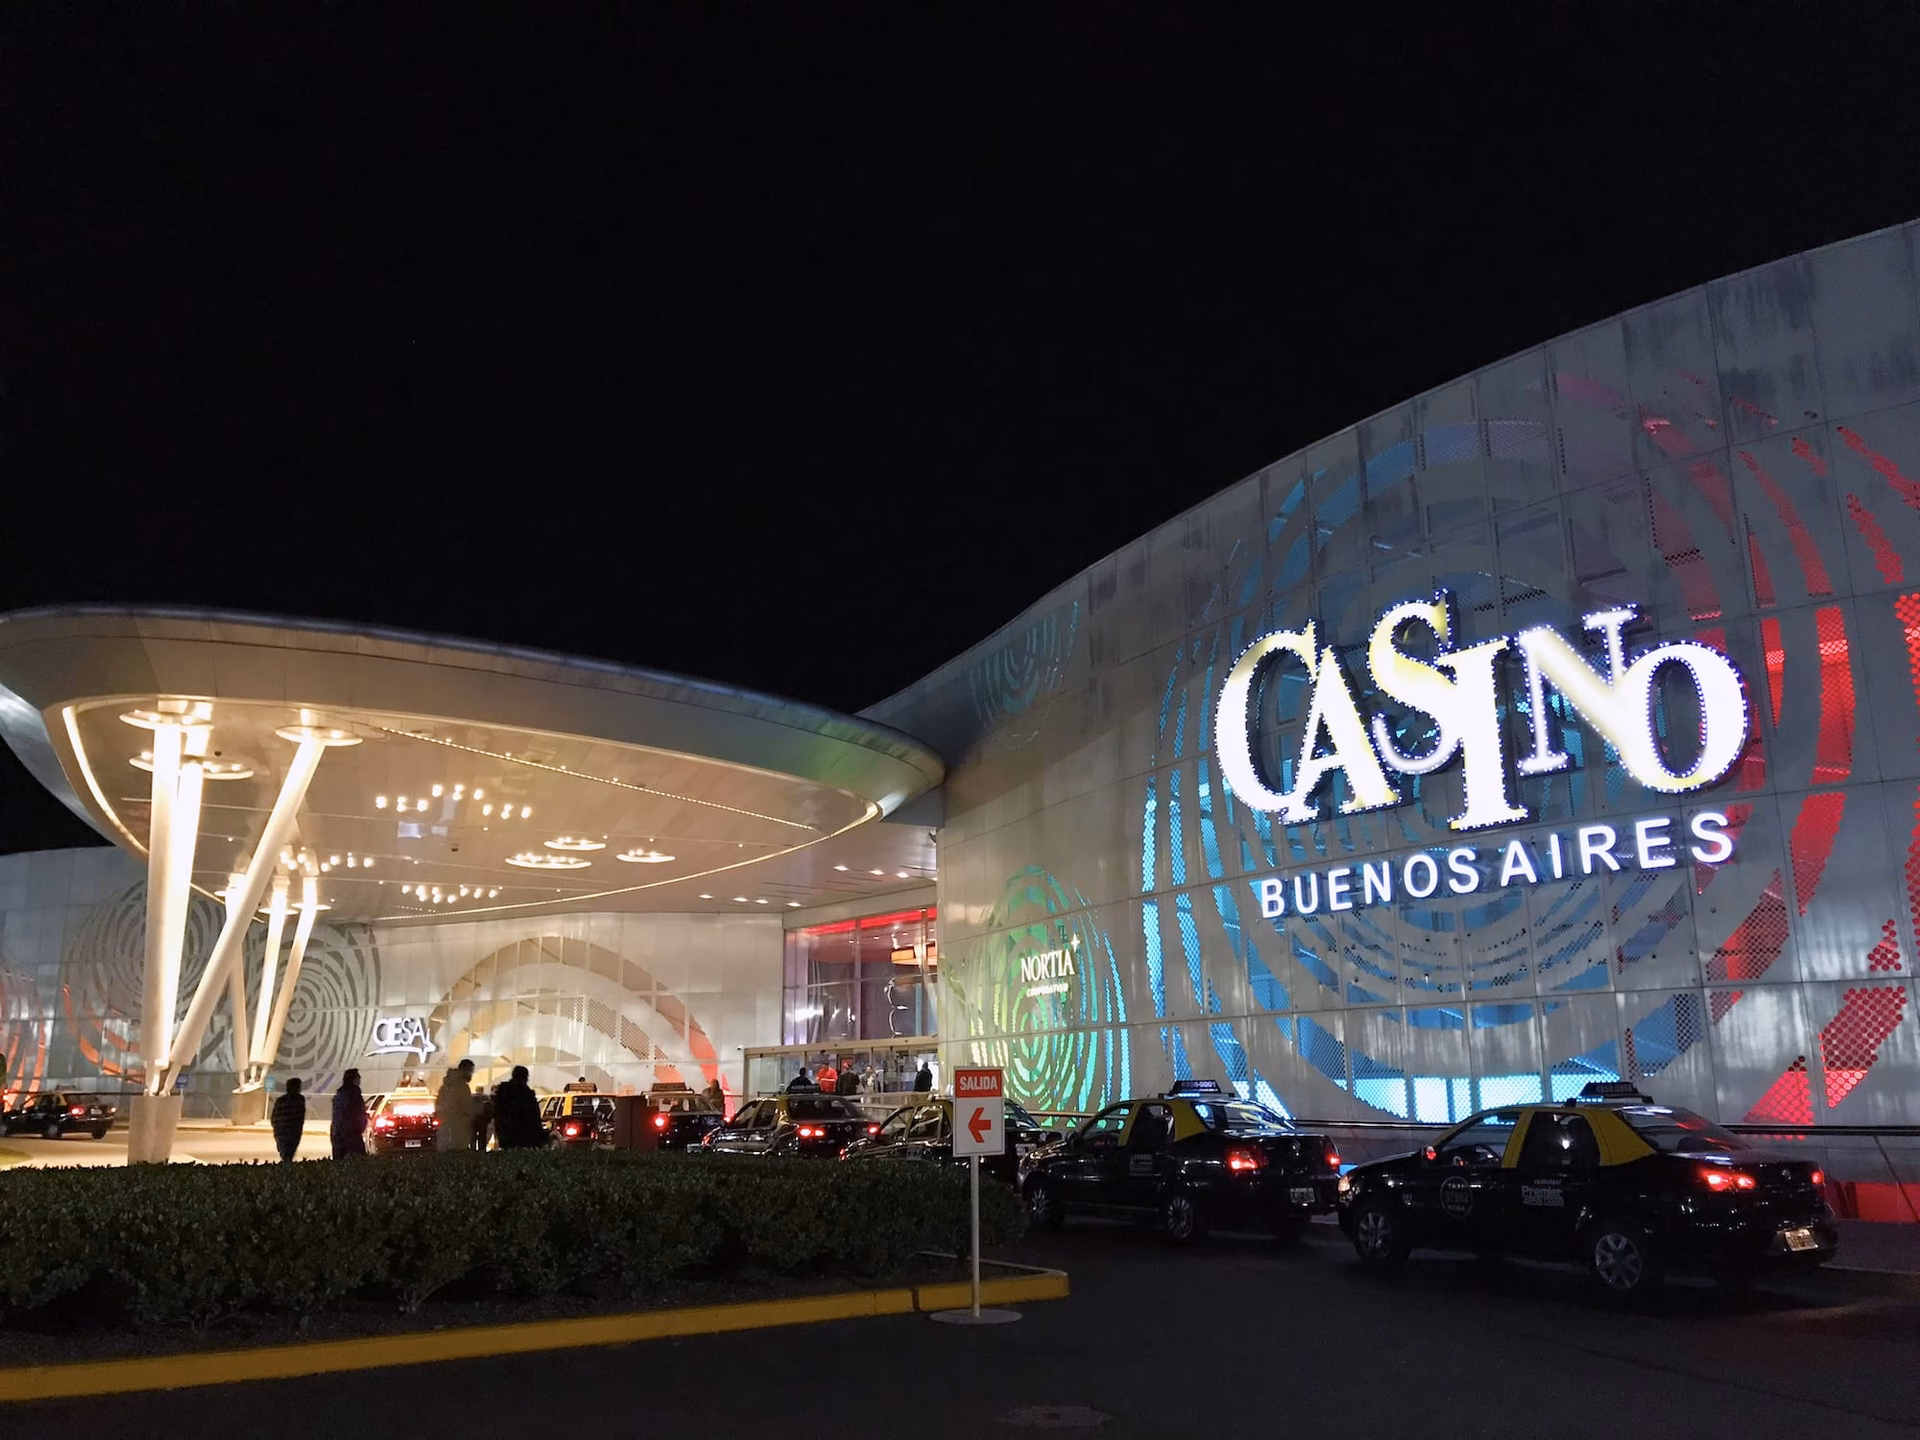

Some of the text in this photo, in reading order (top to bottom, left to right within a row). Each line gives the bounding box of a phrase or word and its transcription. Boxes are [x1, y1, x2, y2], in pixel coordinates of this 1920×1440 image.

[1213, 588, 1749, 832] CASINO
[1260, 811, 1735, 919] BUENOS AIRES
[1020, 949, 1076, 983] NORTIA
[959, 1075, 998, 1091] SALIDA
